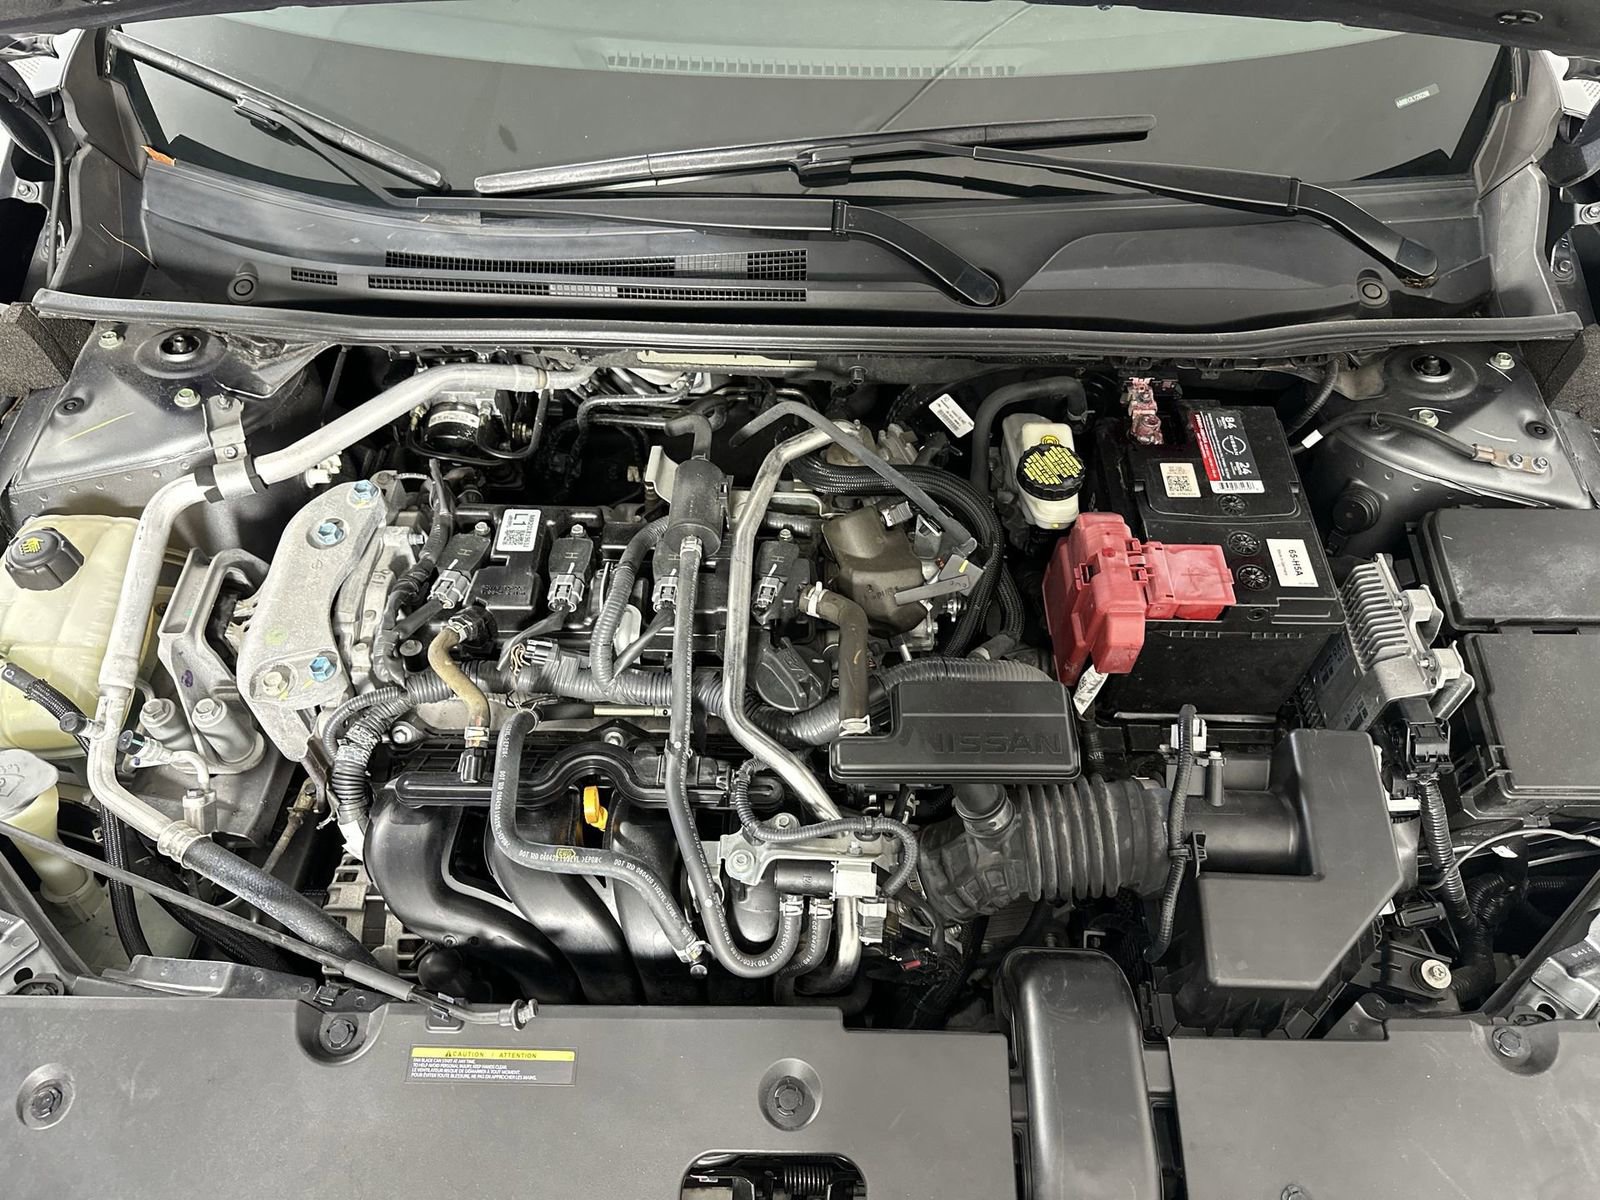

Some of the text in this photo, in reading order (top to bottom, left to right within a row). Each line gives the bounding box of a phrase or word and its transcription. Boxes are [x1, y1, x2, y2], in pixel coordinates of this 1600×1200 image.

[1225, 416, 1237, 429] 84
[1239, 462, 1252, 475] 24
[513, 514, 528, 525] L1
[924, 733, 1064, 754] NISSAN
